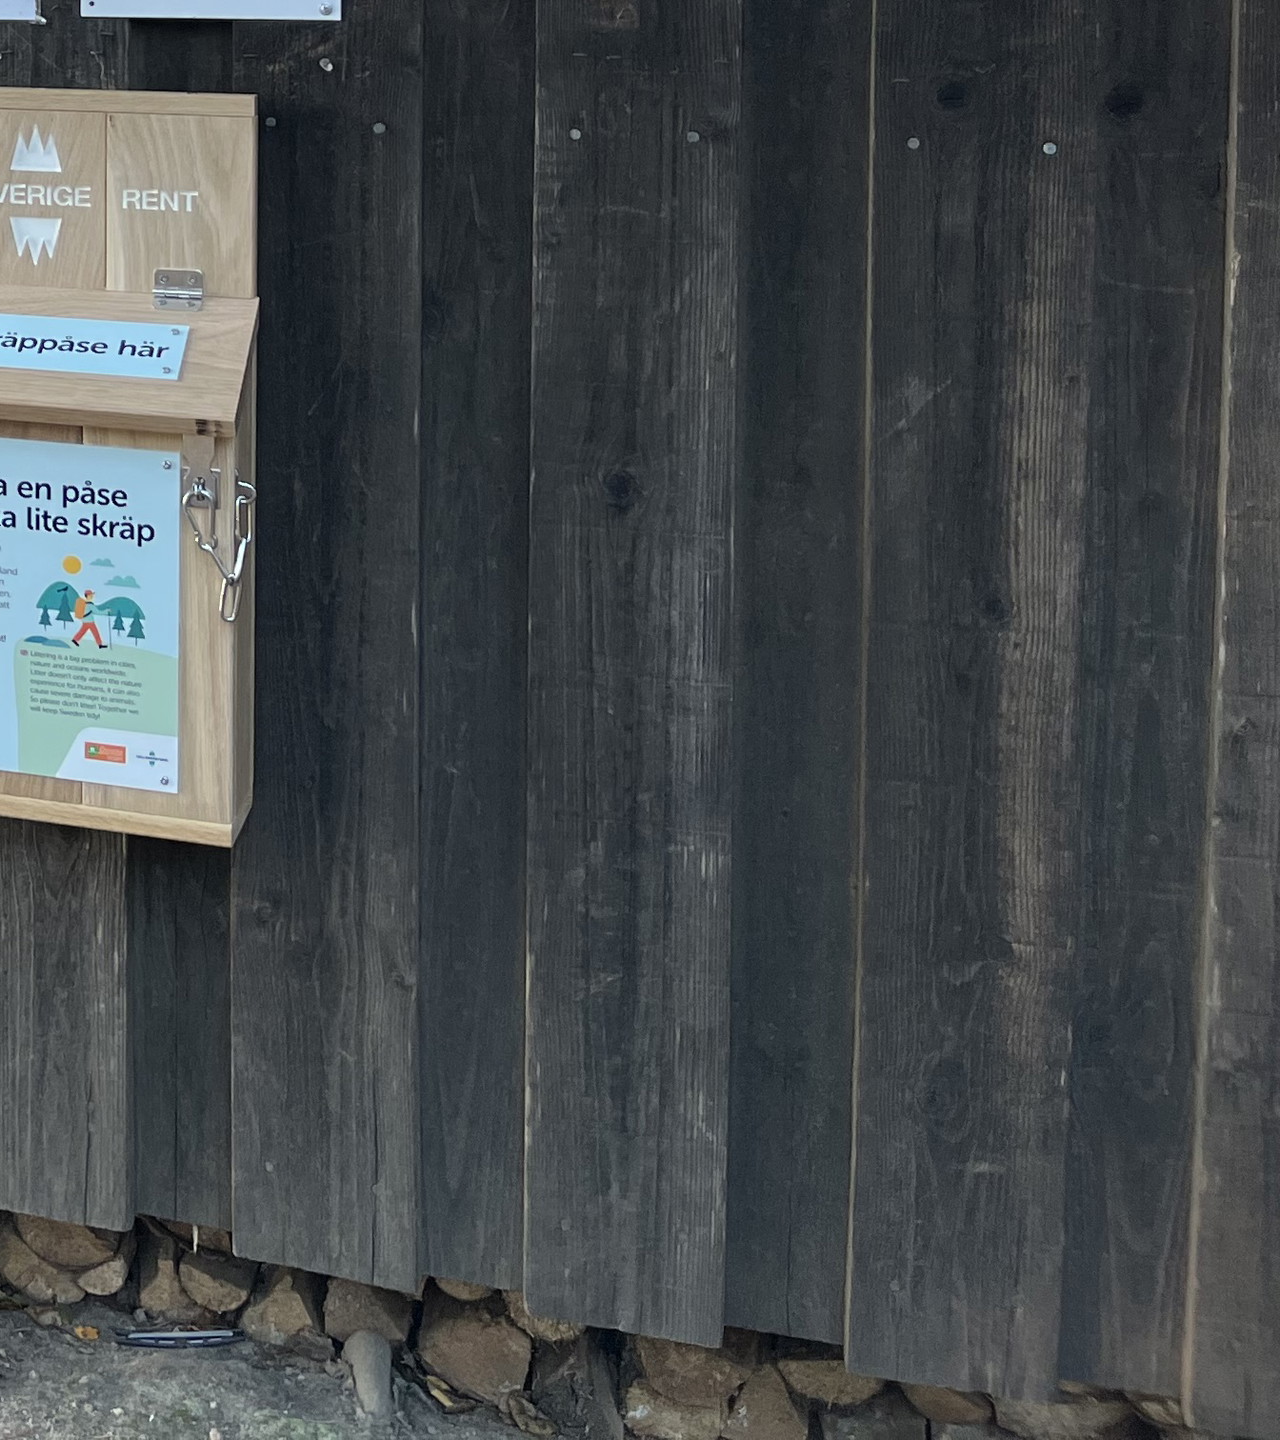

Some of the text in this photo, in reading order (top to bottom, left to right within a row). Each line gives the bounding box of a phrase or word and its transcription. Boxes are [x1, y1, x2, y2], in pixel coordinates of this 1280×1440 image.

[122, 189, 199, 212] RENT
[118, 338, 170, 359] här
[18, 480, 52, 500] en
[62, 481, 128, 511] påse
[27, 507, 67, 532] lite
[78, 513, 154, 546] skräp
